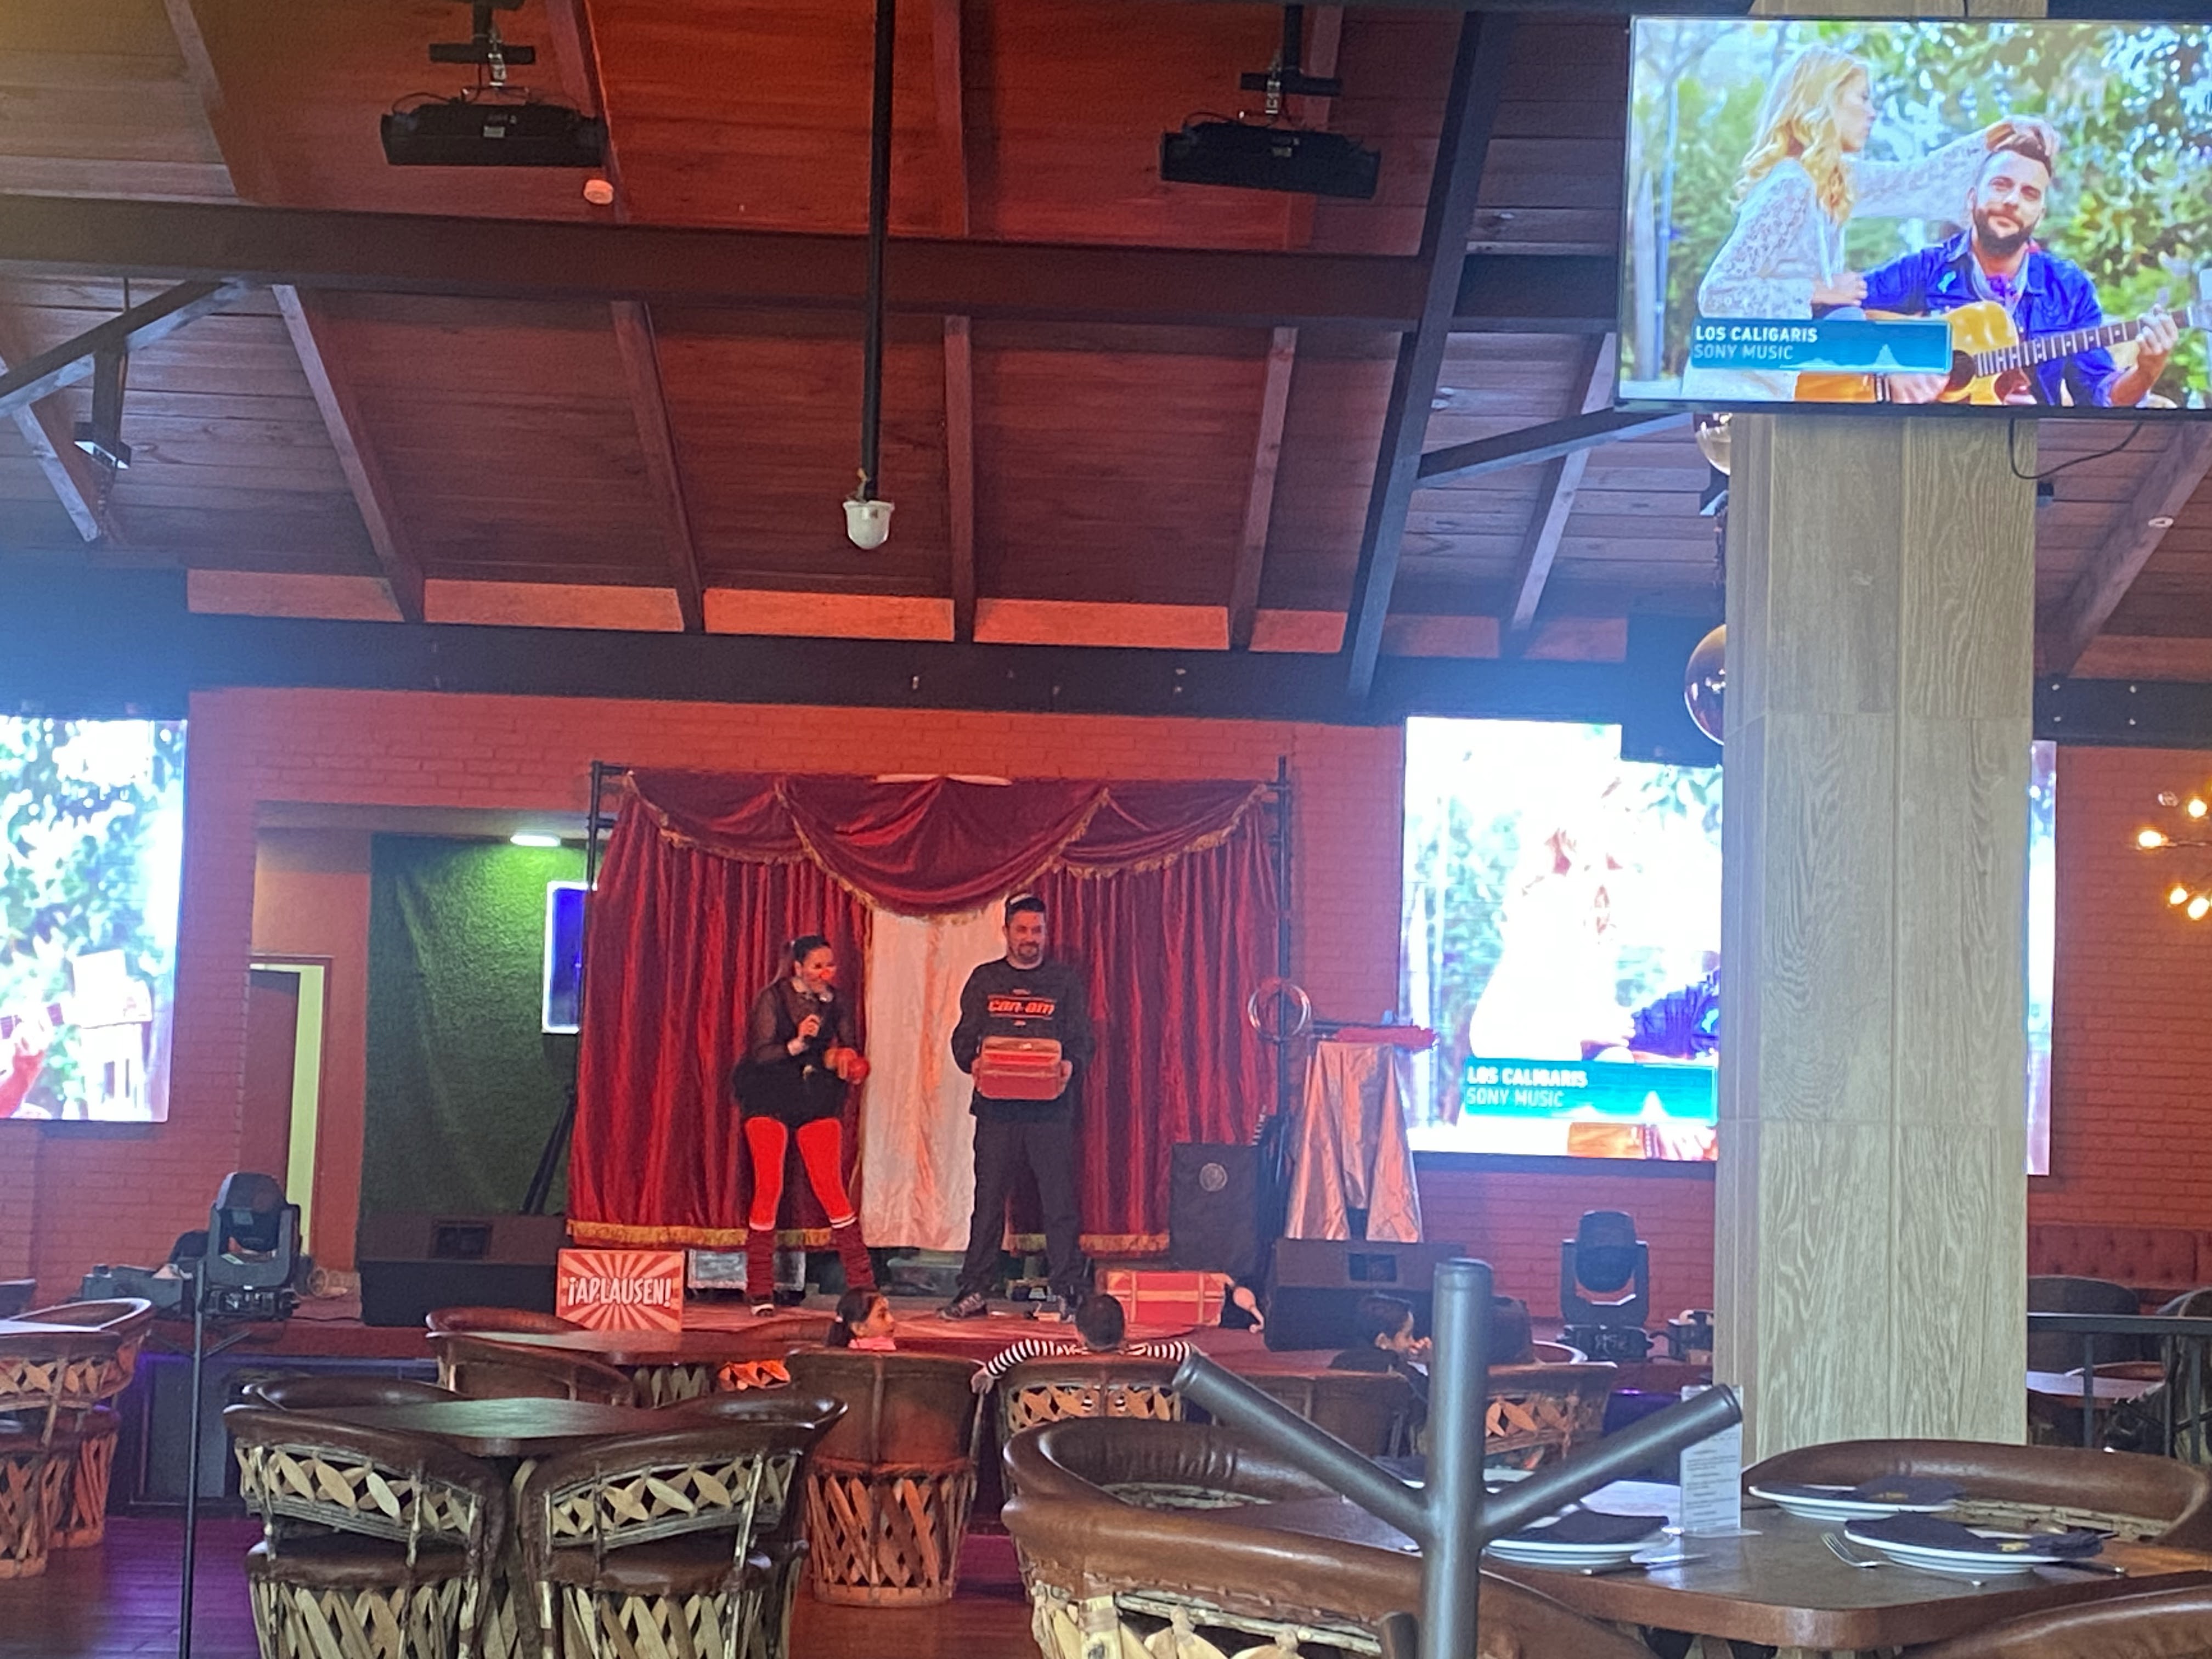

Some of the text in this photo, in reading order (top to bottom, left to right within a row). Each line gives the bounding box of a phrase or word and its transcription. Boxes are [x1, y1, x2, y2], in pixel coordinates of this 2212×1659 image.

[1696, 326, 1818, 342] LOS CALIGARIS
[1694, 344, 1793, 359] SONY MUSIC
[1467, 1087, 1564, 1108] SONY MUSIC
[567, 1277, 672, 1307] ¡APLAUSEN!
